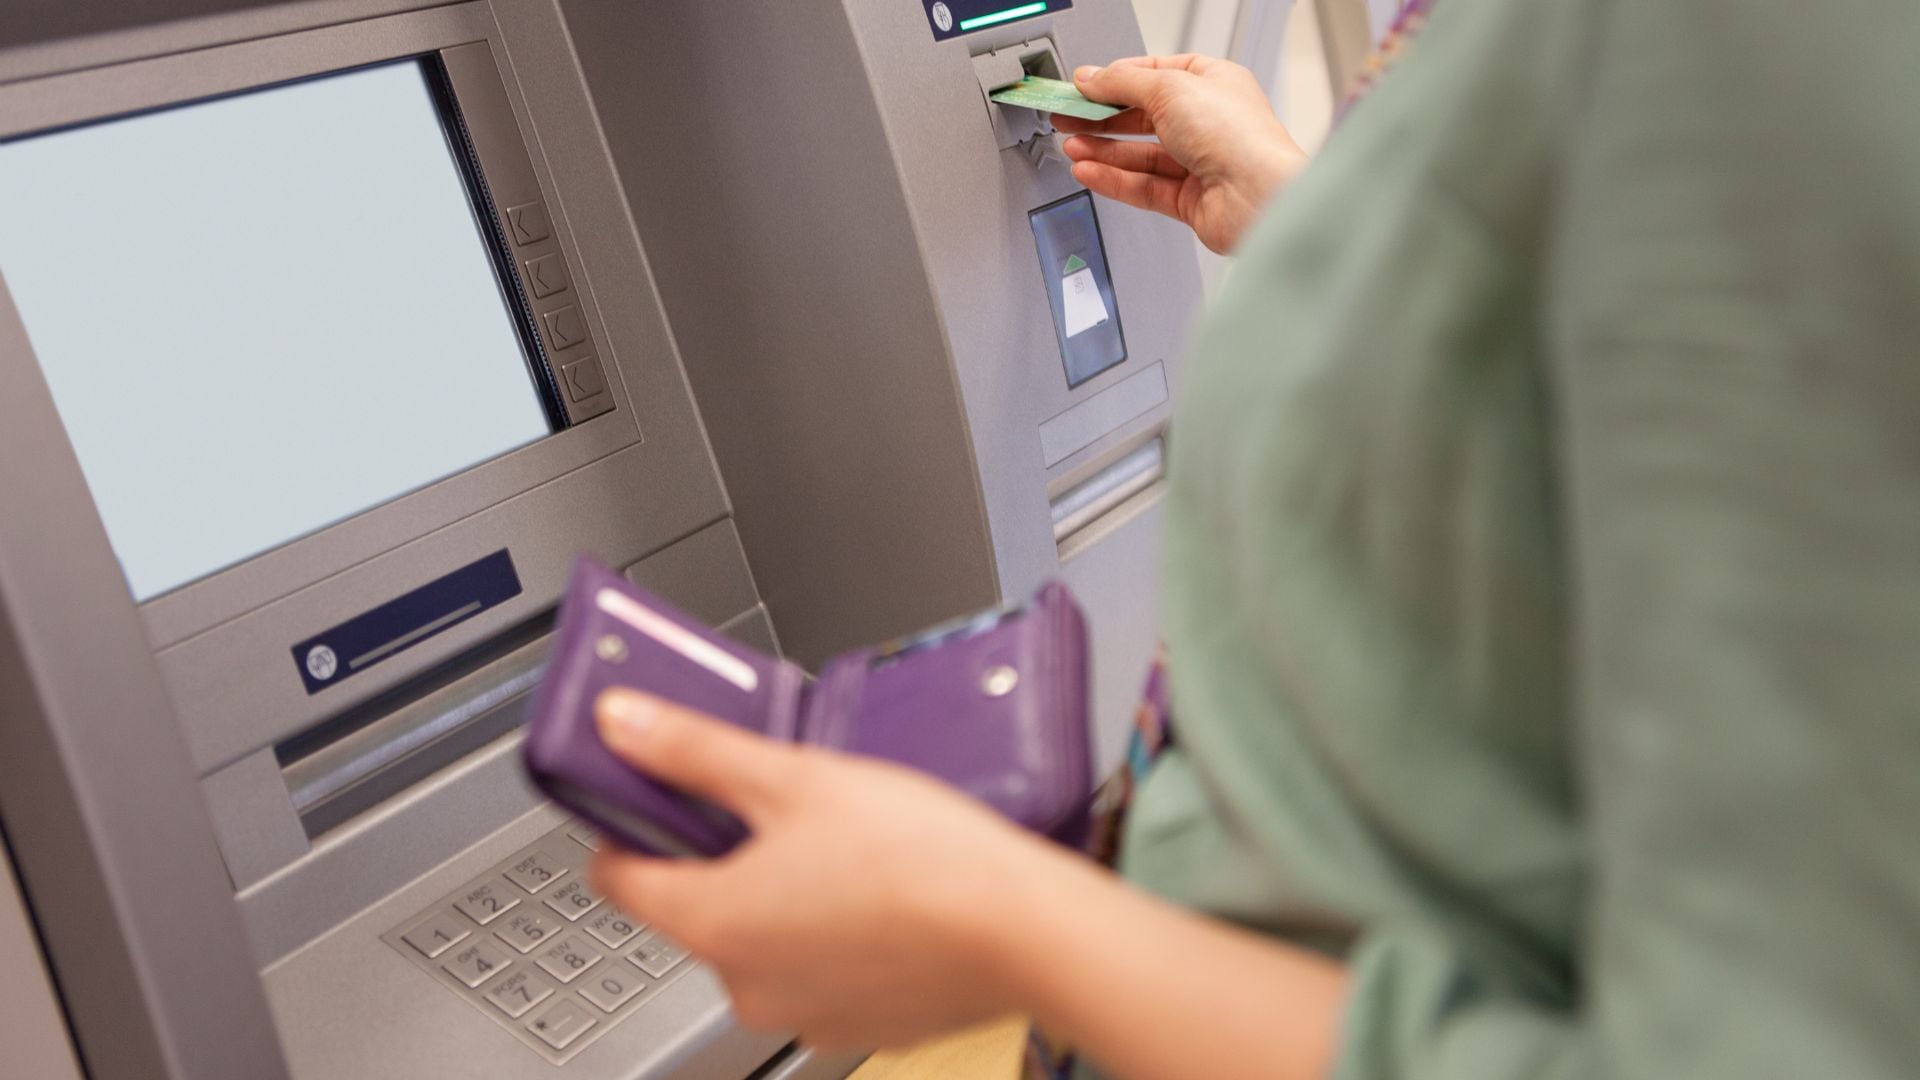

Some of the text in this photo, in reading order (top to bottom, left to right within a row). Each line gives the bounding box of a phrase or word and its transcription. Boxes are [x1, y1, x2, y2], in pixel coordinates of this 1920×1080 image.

[531, 866, 552, 882] 3
[467, 885, 491, 904] ABC
[553, 881, 580, 900] MNO
[481, 896, 505, 912] 2
[571, 894, 592, 909] 6
[433, 929, 451, 943] 1
[523, 923, 544, 940] 5
[612, 921, 632, 936] 9
[476, 958, 493, 973] 4
[564, 954, 586, 969] 8
[513, 986, 532, 1003] 7
[601, 979, 622, 995] 0
